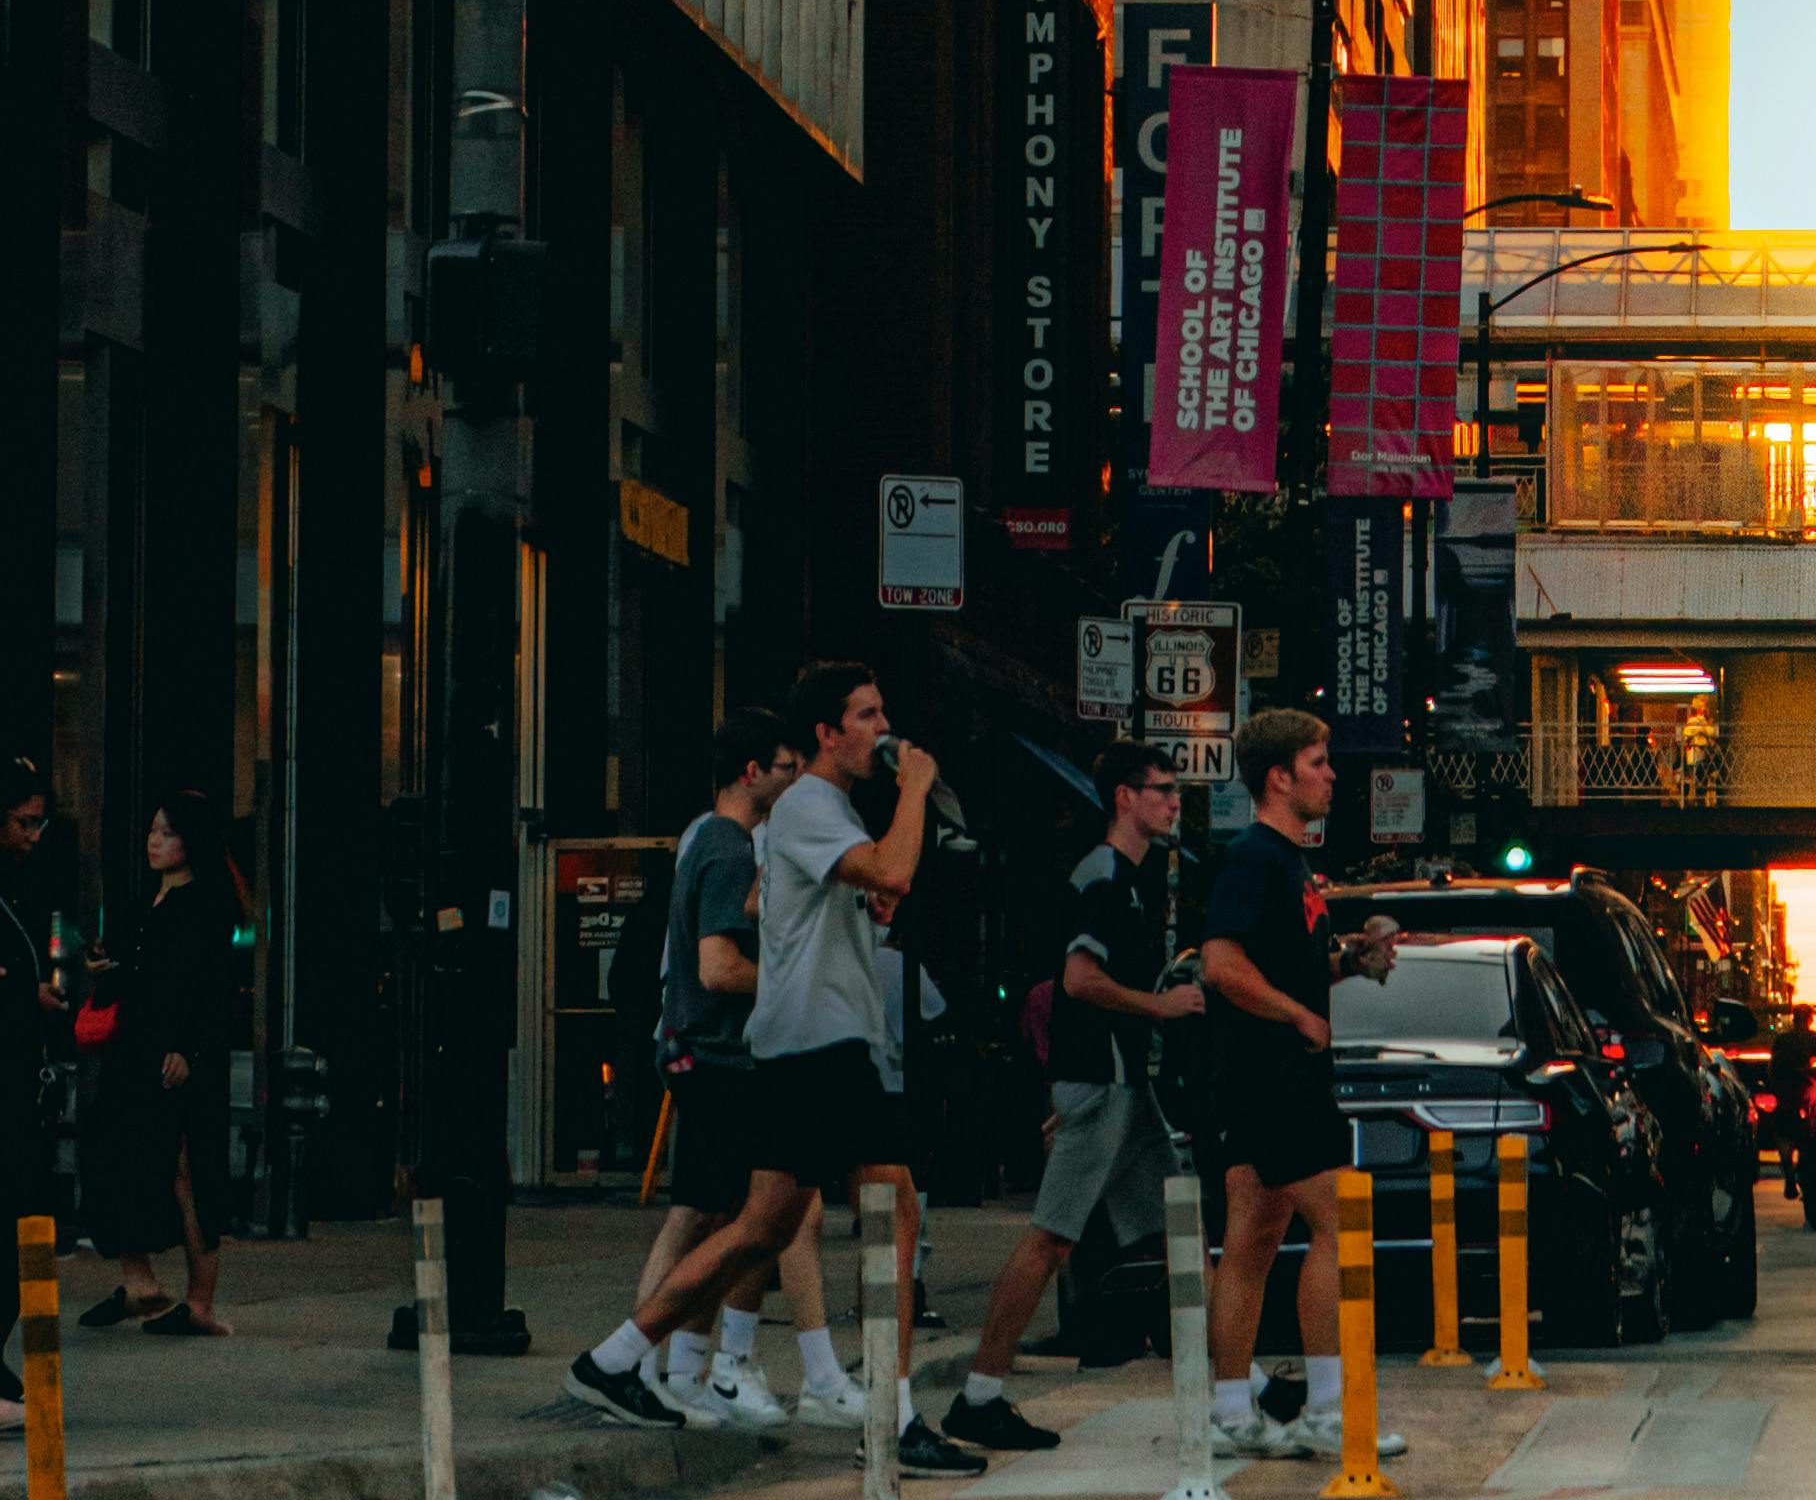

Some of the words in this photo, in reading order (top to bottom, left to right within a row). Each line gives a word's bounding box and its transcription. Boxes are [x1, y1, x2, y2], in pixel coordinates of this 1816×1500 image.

[1212, 128, 1242, 290] INSTITUTE
[1184, 249, 1208, 293] OF
[1208, 297, 1233, 363] ART
[1236, 239, 1264, 382] CHICAGO
[1024, 275, 1054, 474] STORE
[1176, 300, 1204, 431] SCHOOL
[1204, 368, 1230, 431] THE
[1233, 388, 1256, 433] OF
[1356, 518, 1371, 624] INSTITUTE
[886, 587, 913, 604] TOW
[918, 588, 955, 605] ZONE
[1146, 609, 1215, 624] HISTORIC
[1338, 598, 1352, 627] OF
[1154, 640, 1206, 651] ILLINOIS
[1356, 628, 1370, 670] ART
[1373, 589, 1388, 682] CHICAGO
[1157, 667, 1201, 694] 66
[1337, 631, 1352, 715] SCHOOL
[1355, 674, 1370, 715] THE
[1152, 713, 1201, 727] ROUTE
[1373, 686, 1388, 715] OF
